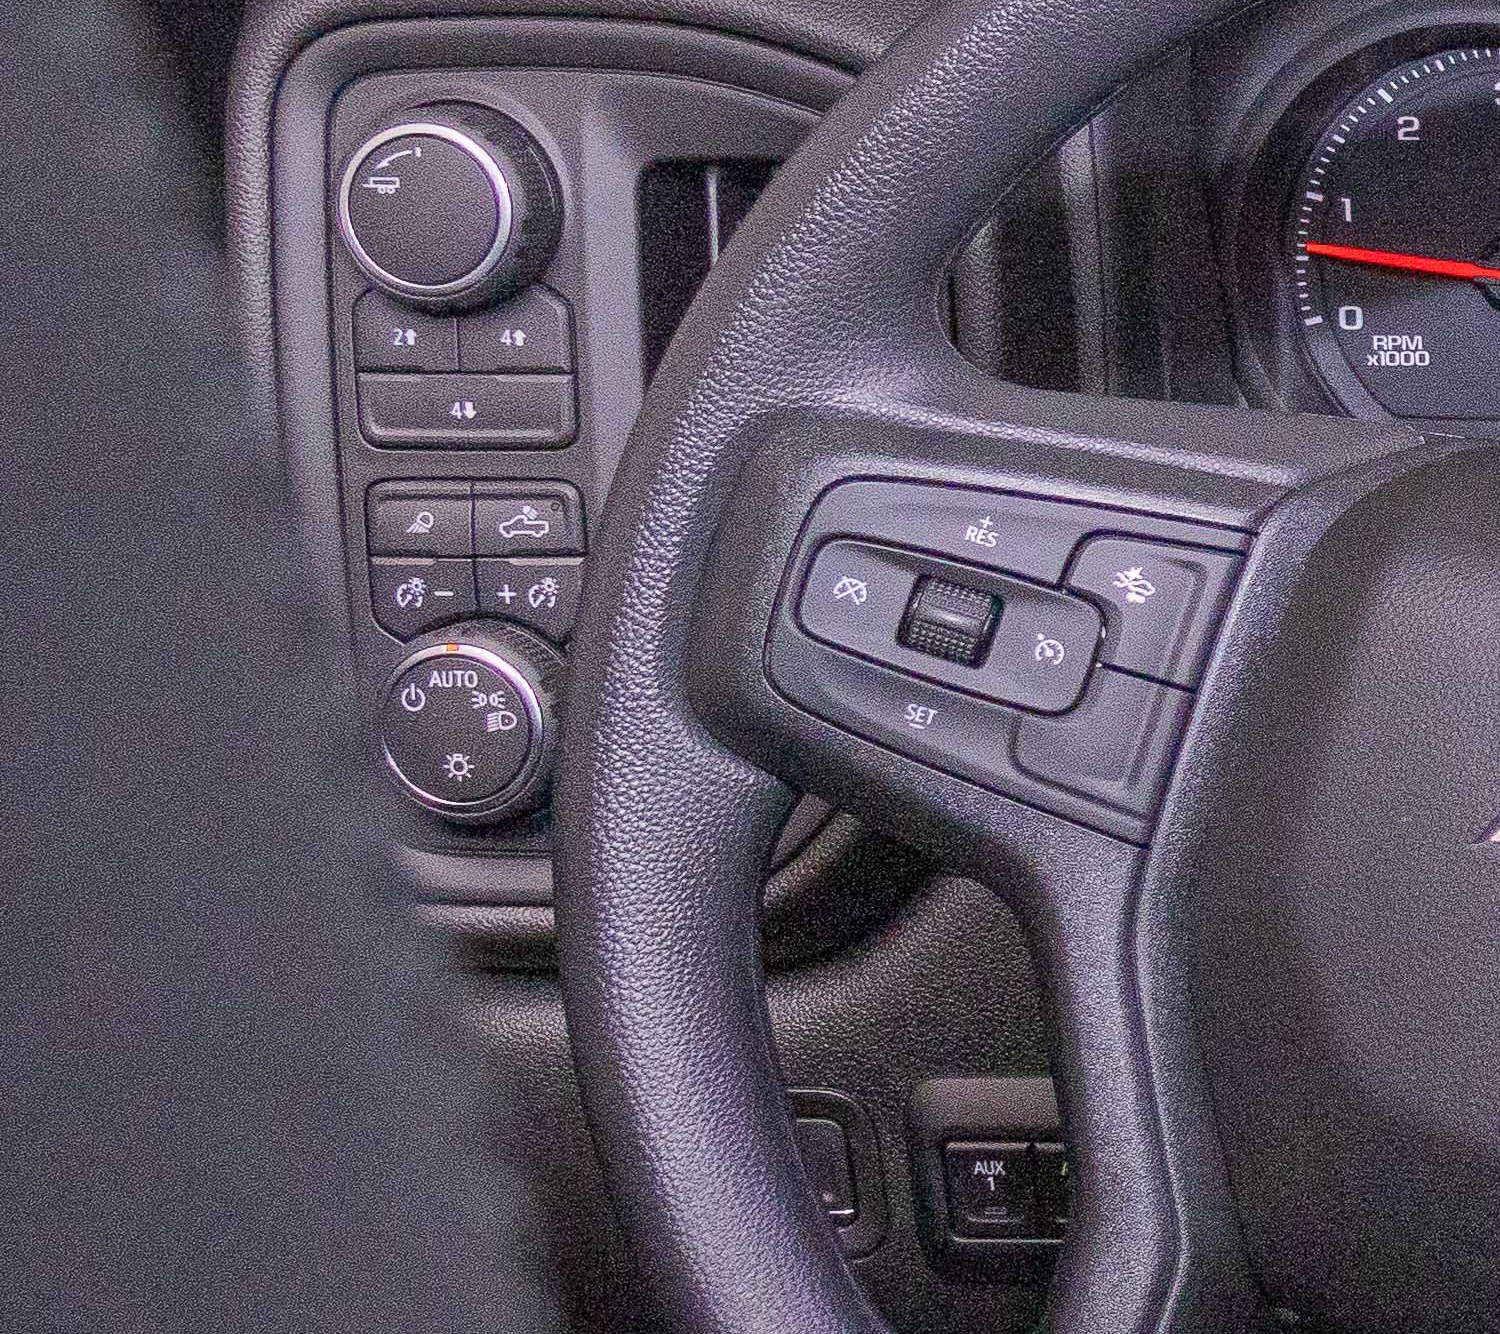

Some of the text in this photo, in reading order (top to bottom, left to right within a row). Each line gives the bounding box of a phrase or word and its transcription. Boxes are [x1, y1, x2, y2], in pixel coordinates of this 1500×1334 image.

[1396, 115, 1420, 141] 2
[1340, 197, 1352, 222] 1
[1338, 305, 1364, 331] 0
[1372, 335, 1423, 351] RPM
[1366, 350, 1430, 366] x1000
[965, 526, 999, 548] RES
[428, 670, 478, 688] AUTO
[904, 703, 938, 725] SET
[973, 1160, 1006, 1176] AUX
[986, 1176, 996, 1192] 1
